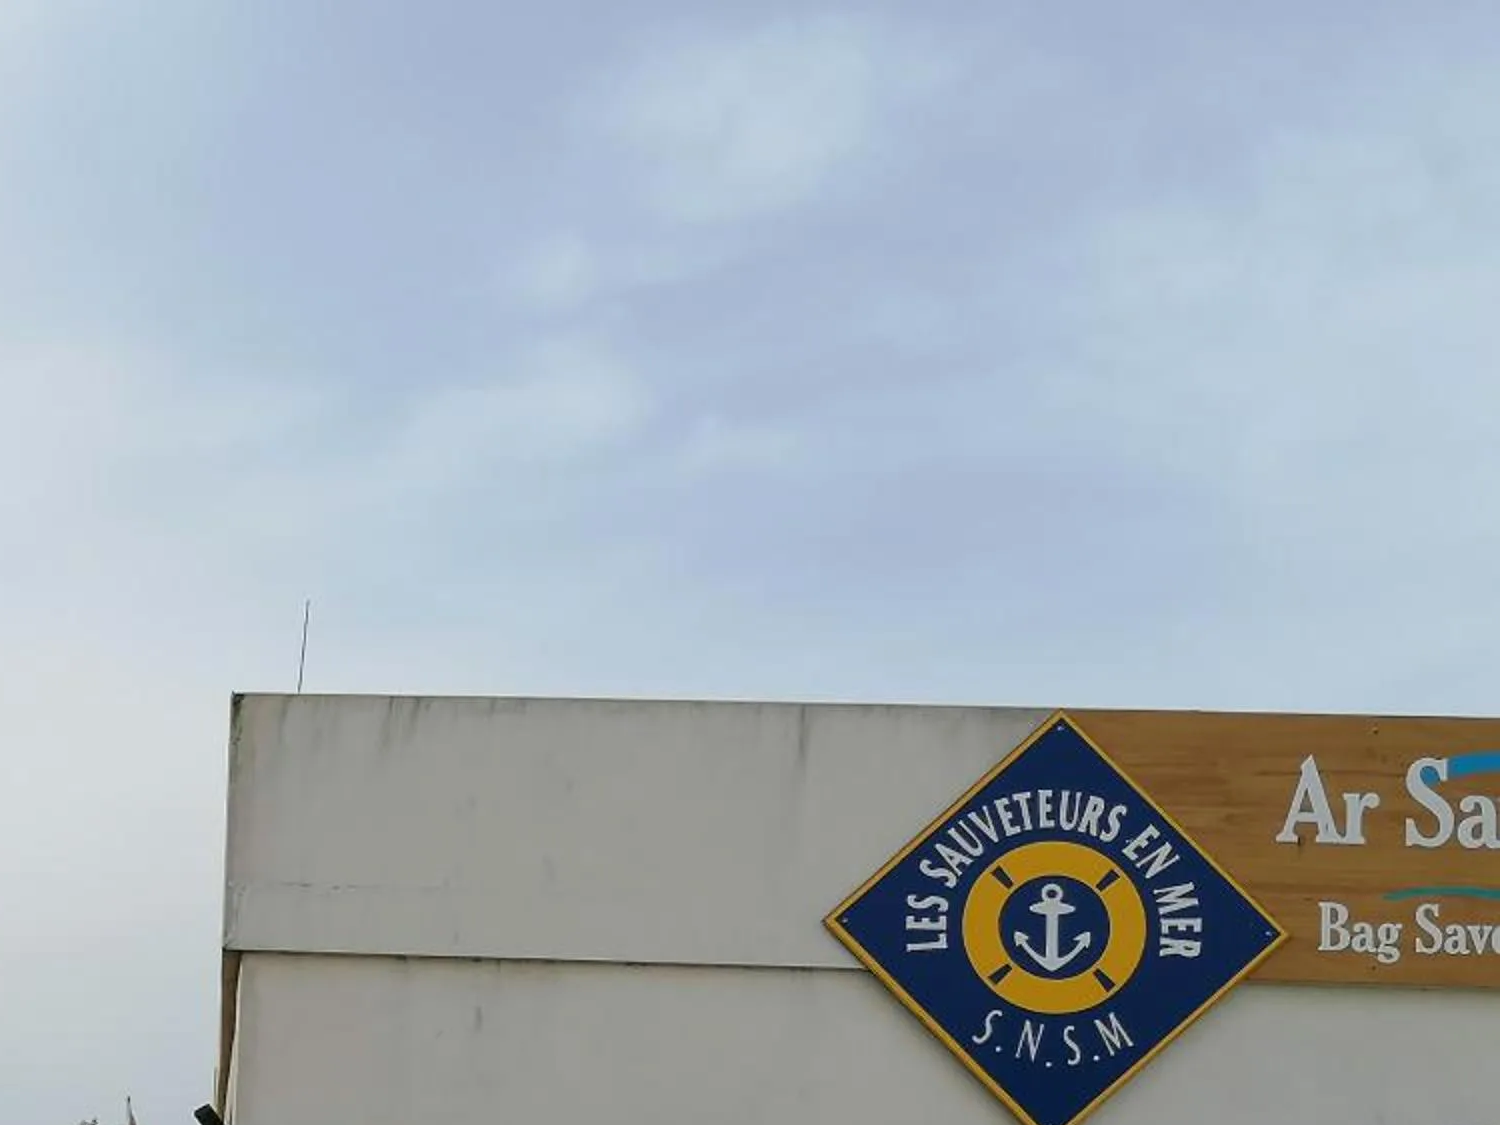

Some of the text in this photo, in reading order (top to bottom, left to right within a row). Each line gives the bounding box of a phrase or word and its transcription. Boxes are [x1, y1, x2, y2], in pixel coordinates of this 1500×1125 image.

[1275, 754, 1500, 849] Ar Sa
[905, 789, 1203, 959] LES SAUVETEURS EN MER
[1317, 901, 1402, 964] Bag
[971, 1009, 1134, 1067] S.N.S.M
